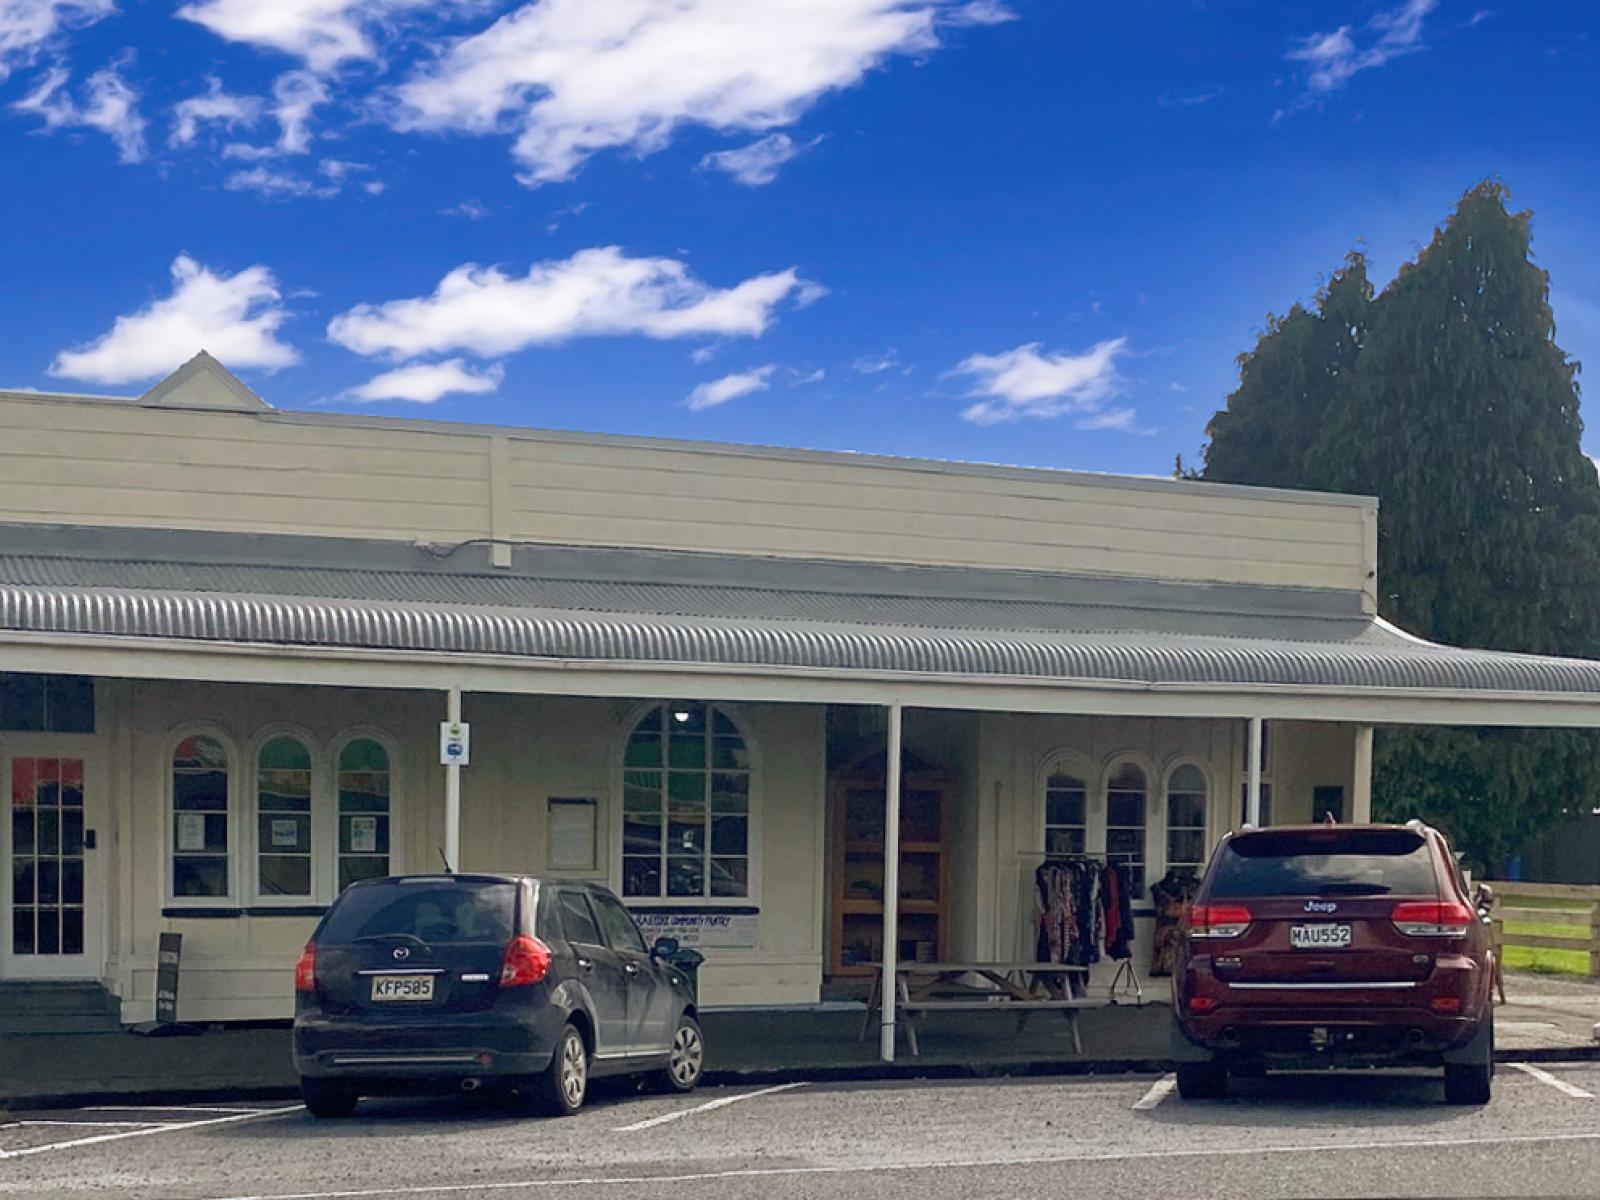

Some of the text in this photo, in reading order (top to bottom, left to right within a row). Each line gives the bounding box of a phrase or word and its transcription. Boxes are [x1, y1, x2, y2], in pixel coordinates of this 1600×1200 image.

[1304, 901, 1337, 913] Jeep
[1292, 928, 1350, 943] MAU552
[375, 980, 431, 995] KFP585
